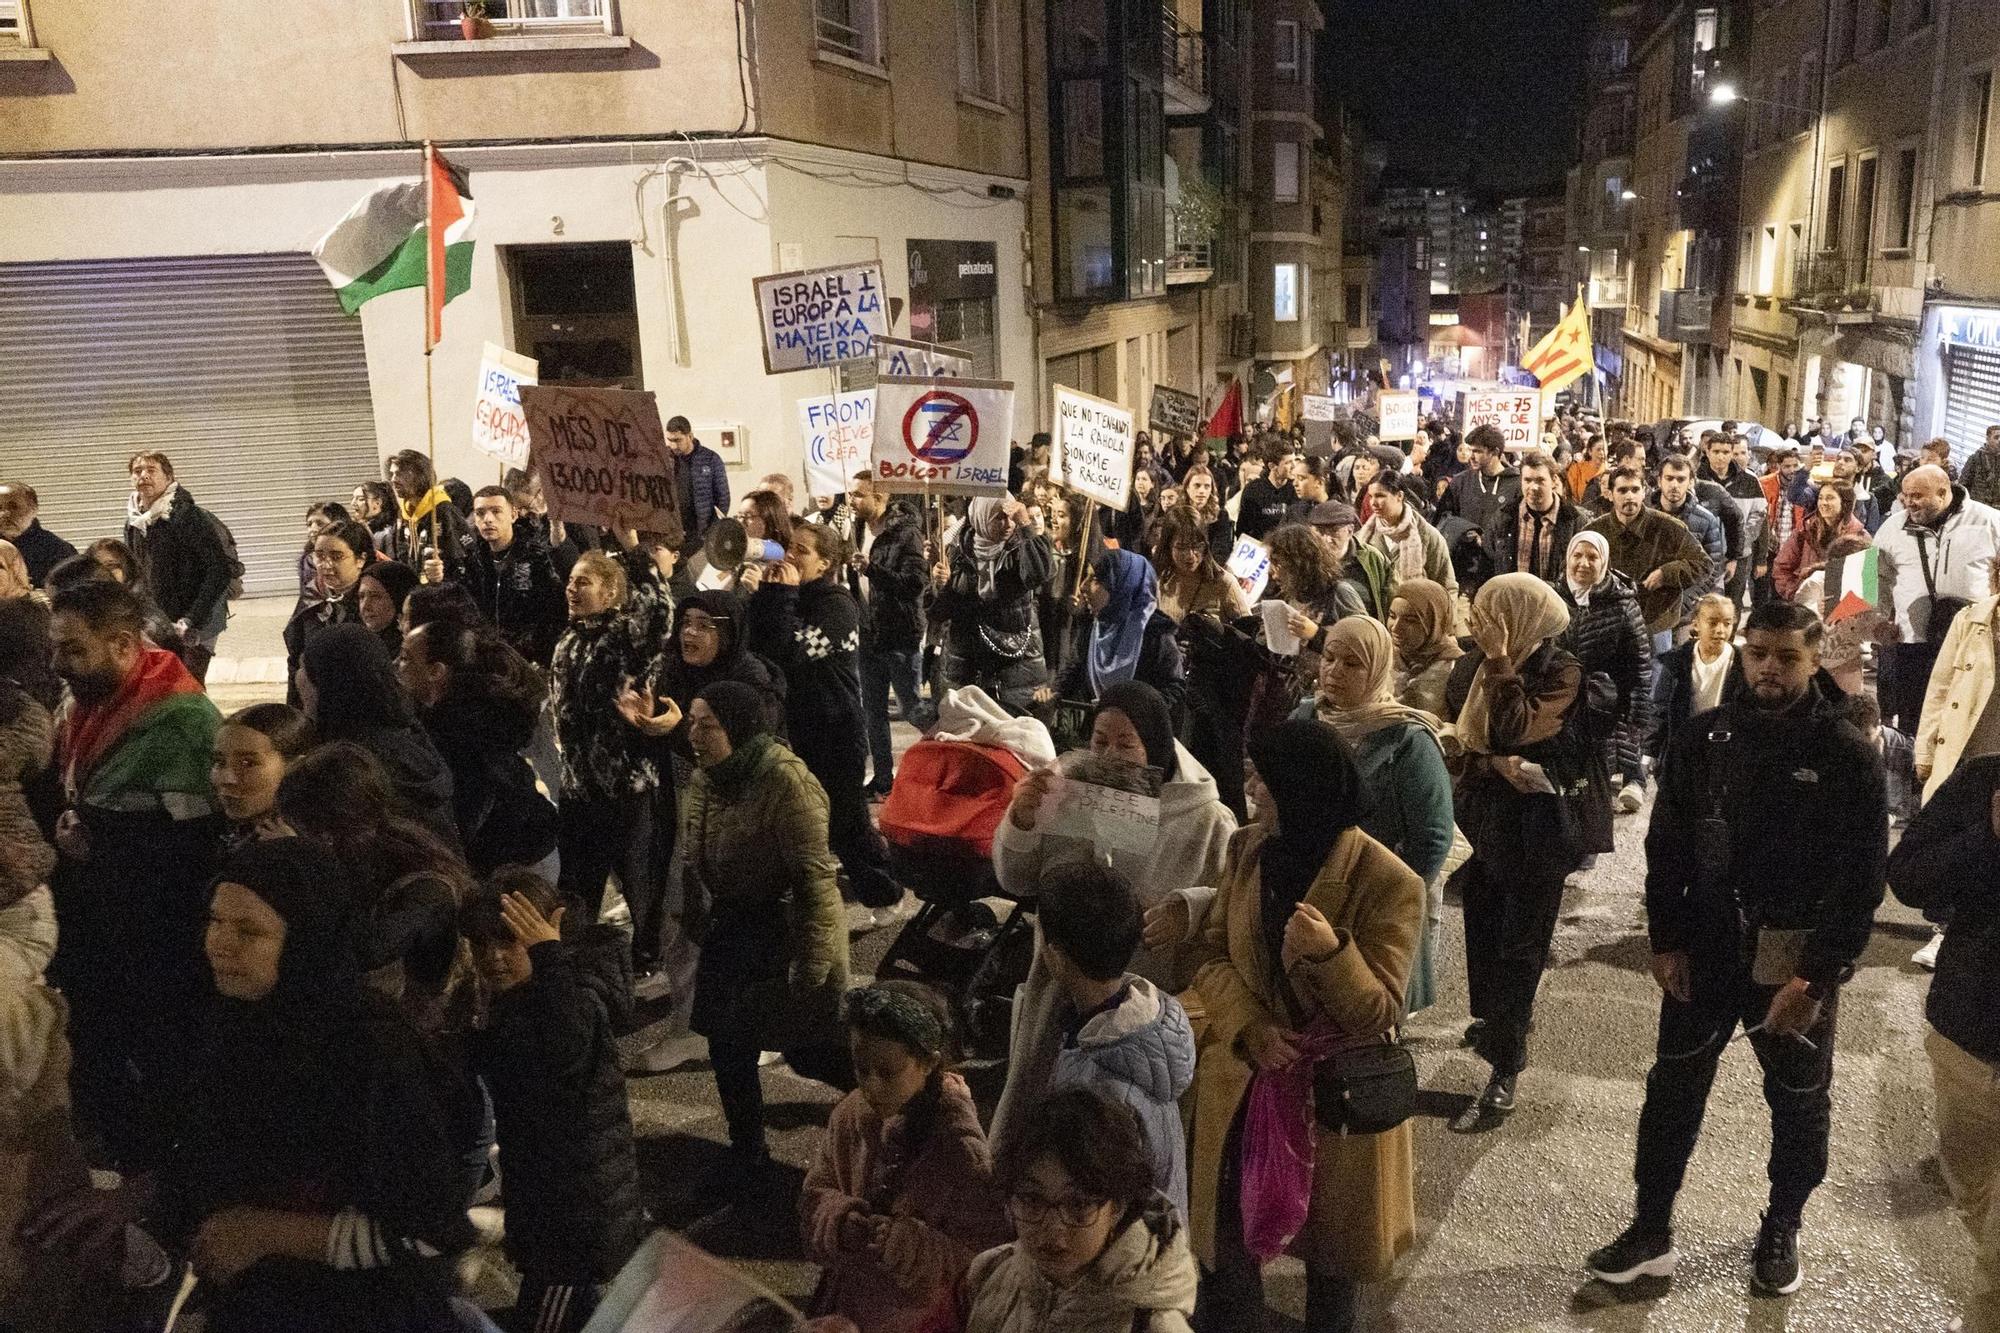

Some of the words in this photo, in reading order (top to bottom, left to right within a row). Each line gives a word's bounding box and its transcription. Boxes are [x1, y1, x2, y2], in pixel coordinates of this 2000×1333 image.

[551, 215, 565, 236] 2
[958, 260, 994, 278] peixateria
[773, 275, 851, 306] ISRAEL
[858, 269, 876, 292] I
[772, 297, 853, 328] EUROPA
[858, 292, 880, 312] LA
[775, 317, 869, 349] MATEIXA
[805, 335, 876, 364] MERDA
[484, 369, 522, 405] ISRAEL
[808, 398, 871, 428] FROM
[1061, 400, 1078, 419] QUE
[1081, 408, 1092, 422] NO
[1496, 402, 1510, 411] DE
[1514, 397, 1532, 412] 75
[1470, 414, 1501, 426] ANYS
[1511, 413, 1530, 424] DE
[603, 418, 638, 459] DE
[828, 423, 874, 449] RIVE
[1071, 423, 1084, 440] LA
[1090, 428, 1125, 455] RAHOLA
